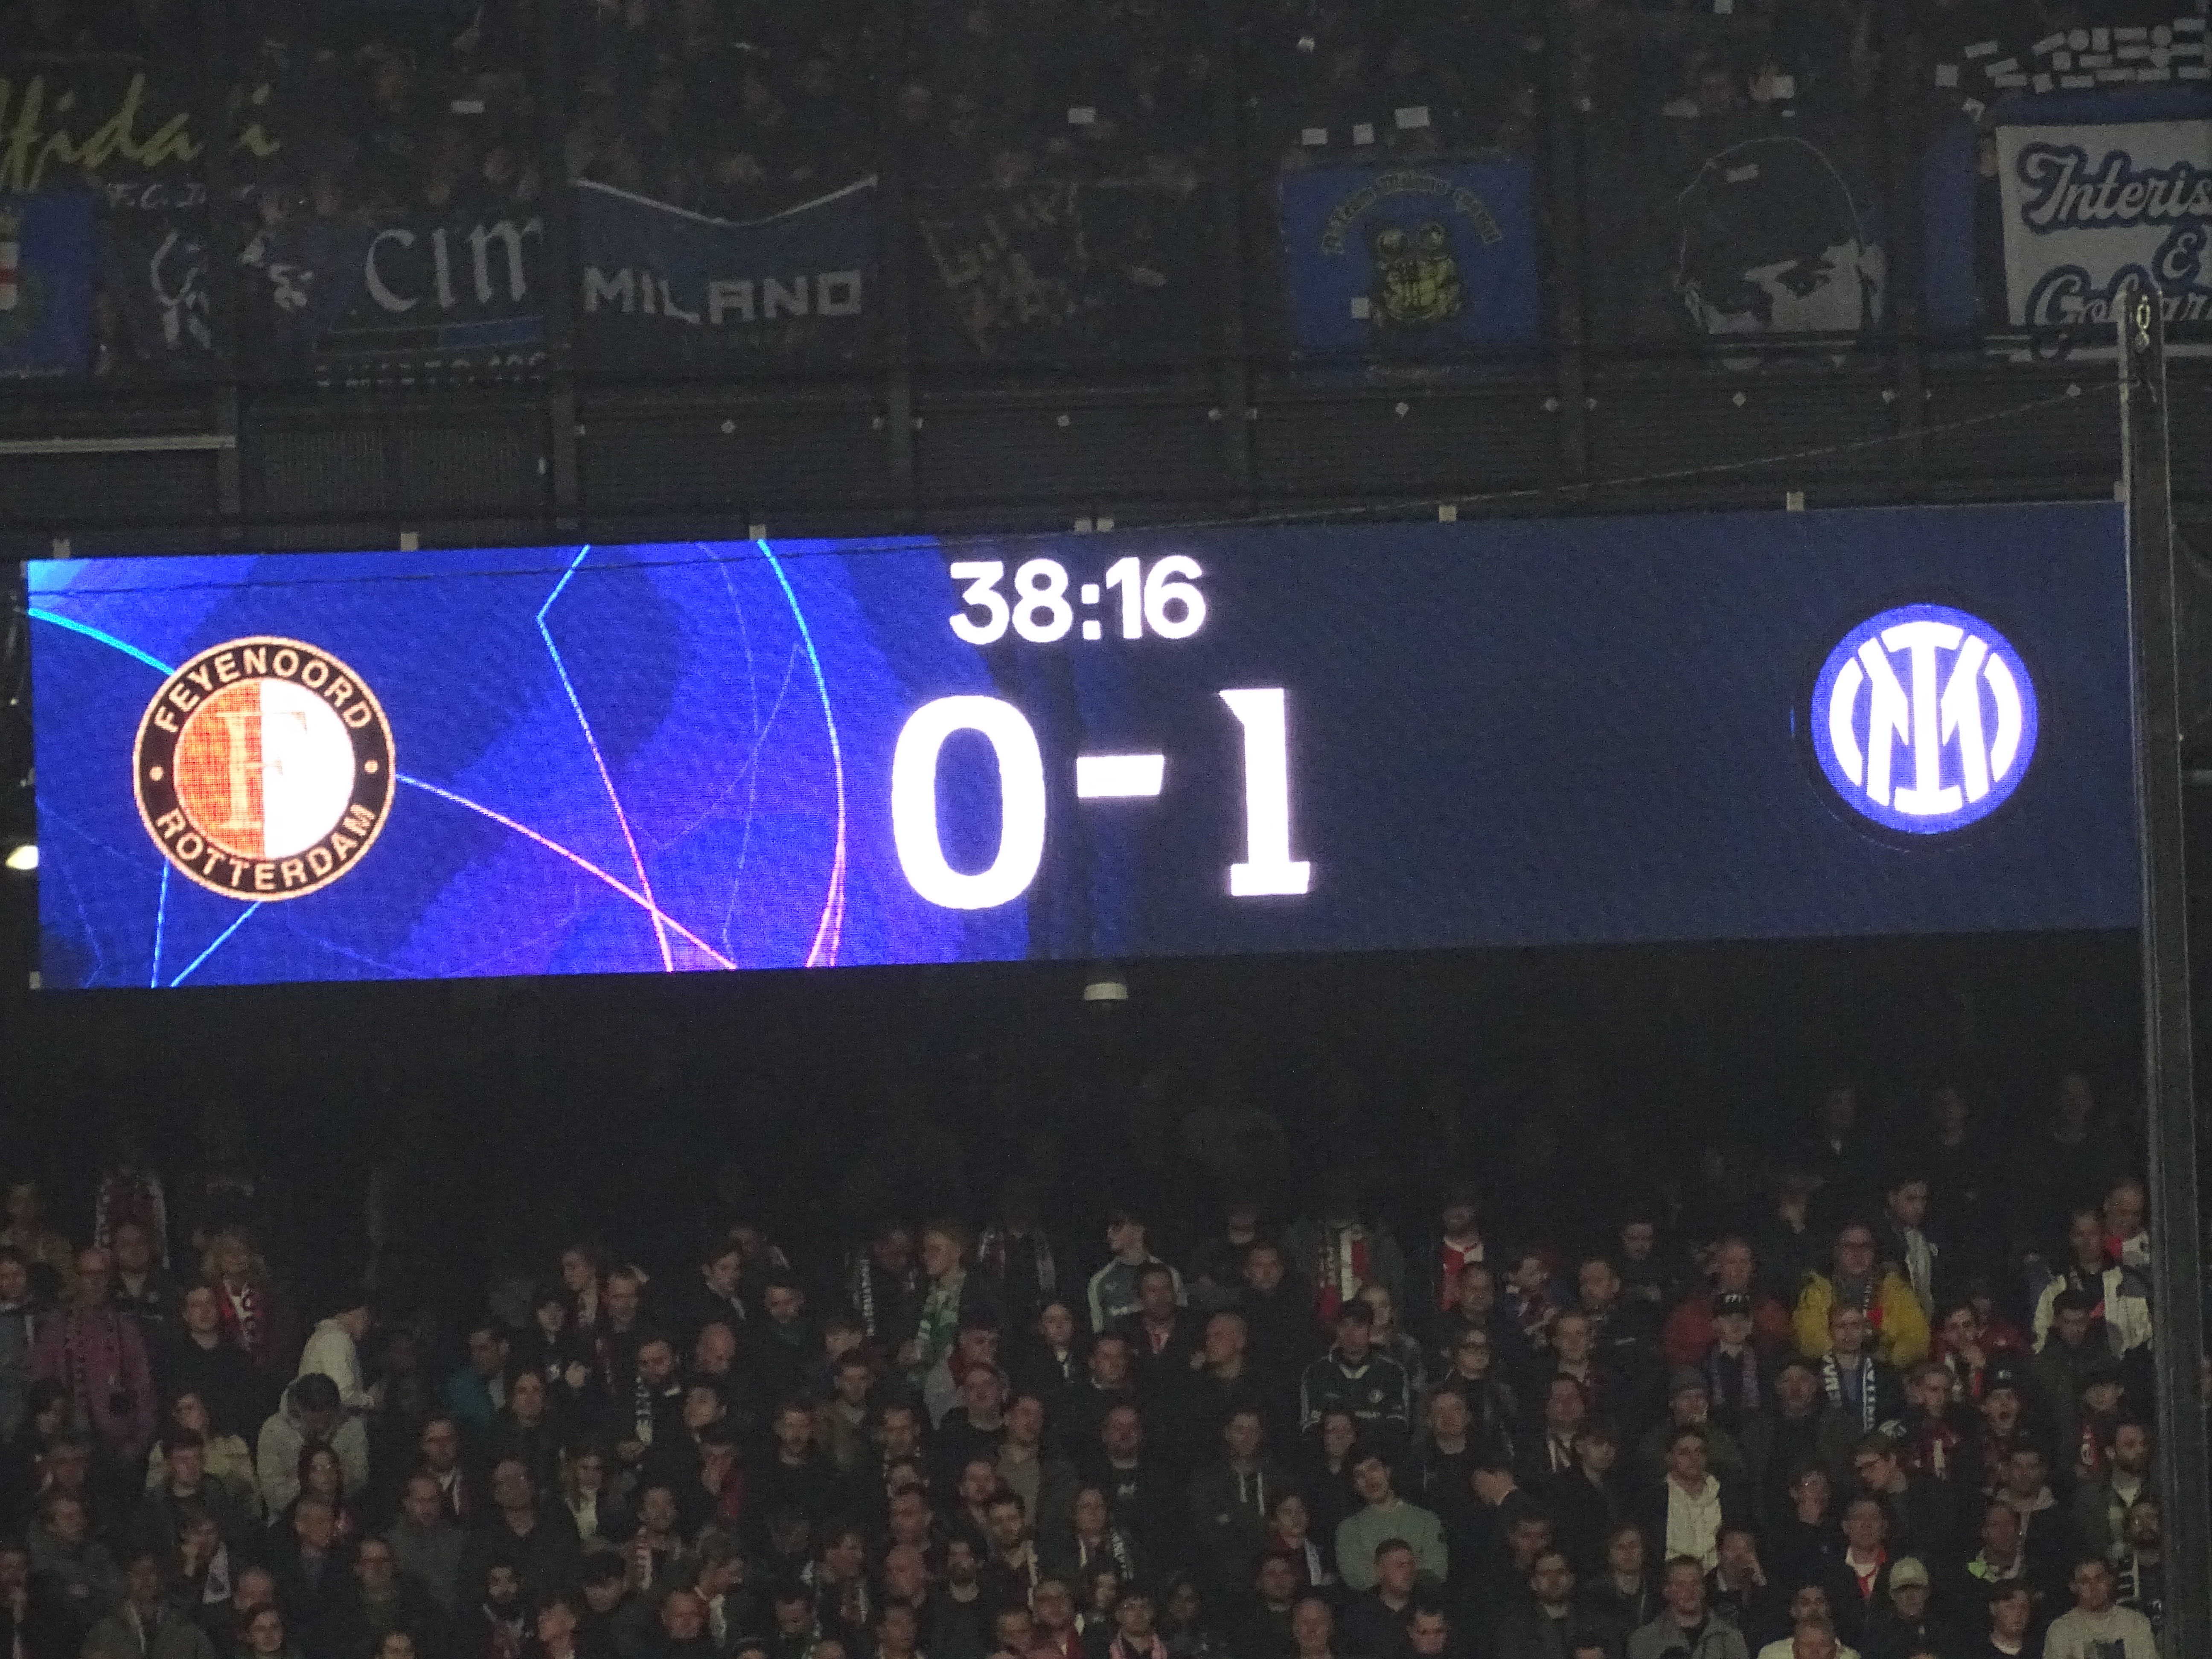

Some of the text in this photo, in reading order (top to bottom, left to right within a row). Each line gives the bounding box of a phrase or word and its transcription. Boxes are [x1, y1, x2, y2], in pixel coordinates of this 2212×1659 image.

[583, 267, 862, 325] MILANO
[949, 555, 1207, 645] 38:16
[154, 646, 373, 733] FEYENOORD
[156, 803, 375, 891] ROTTERDAM
